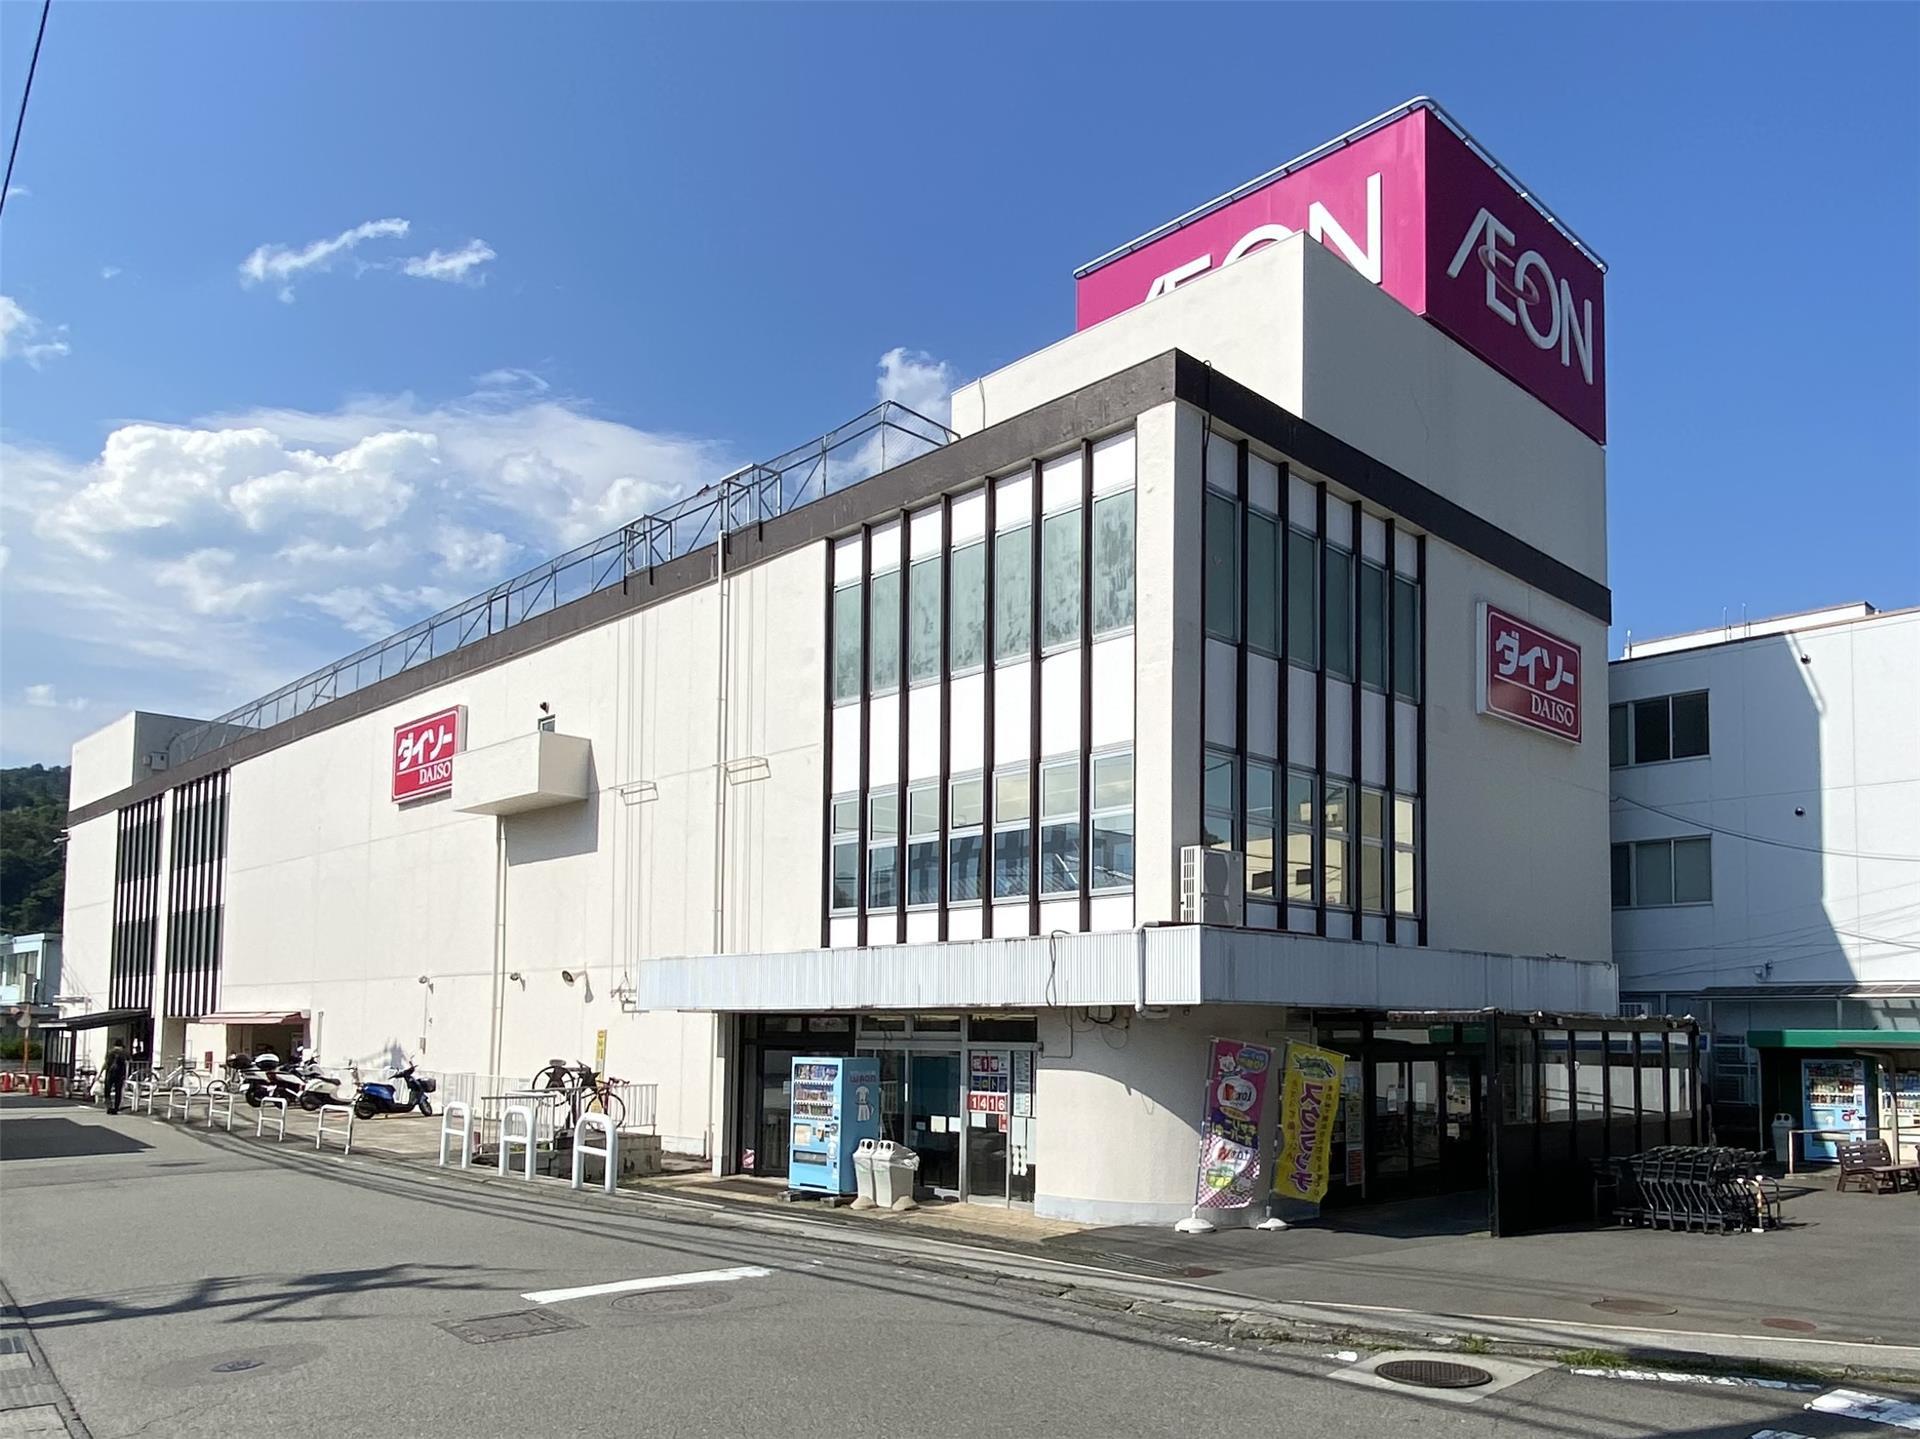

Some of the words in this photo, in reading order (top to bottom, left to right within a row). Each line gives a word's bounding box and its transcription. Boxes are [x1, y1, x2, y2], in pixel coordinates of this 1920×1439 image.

[1496, 631, 1574, 691] ダイソー
[1531, 693, 1574, 727] DAISO
[398, 725, 452, 770] ダイソー
[419, 762, 451, 784] DAISO
[972, 1097, 1005, 1110] 1416
